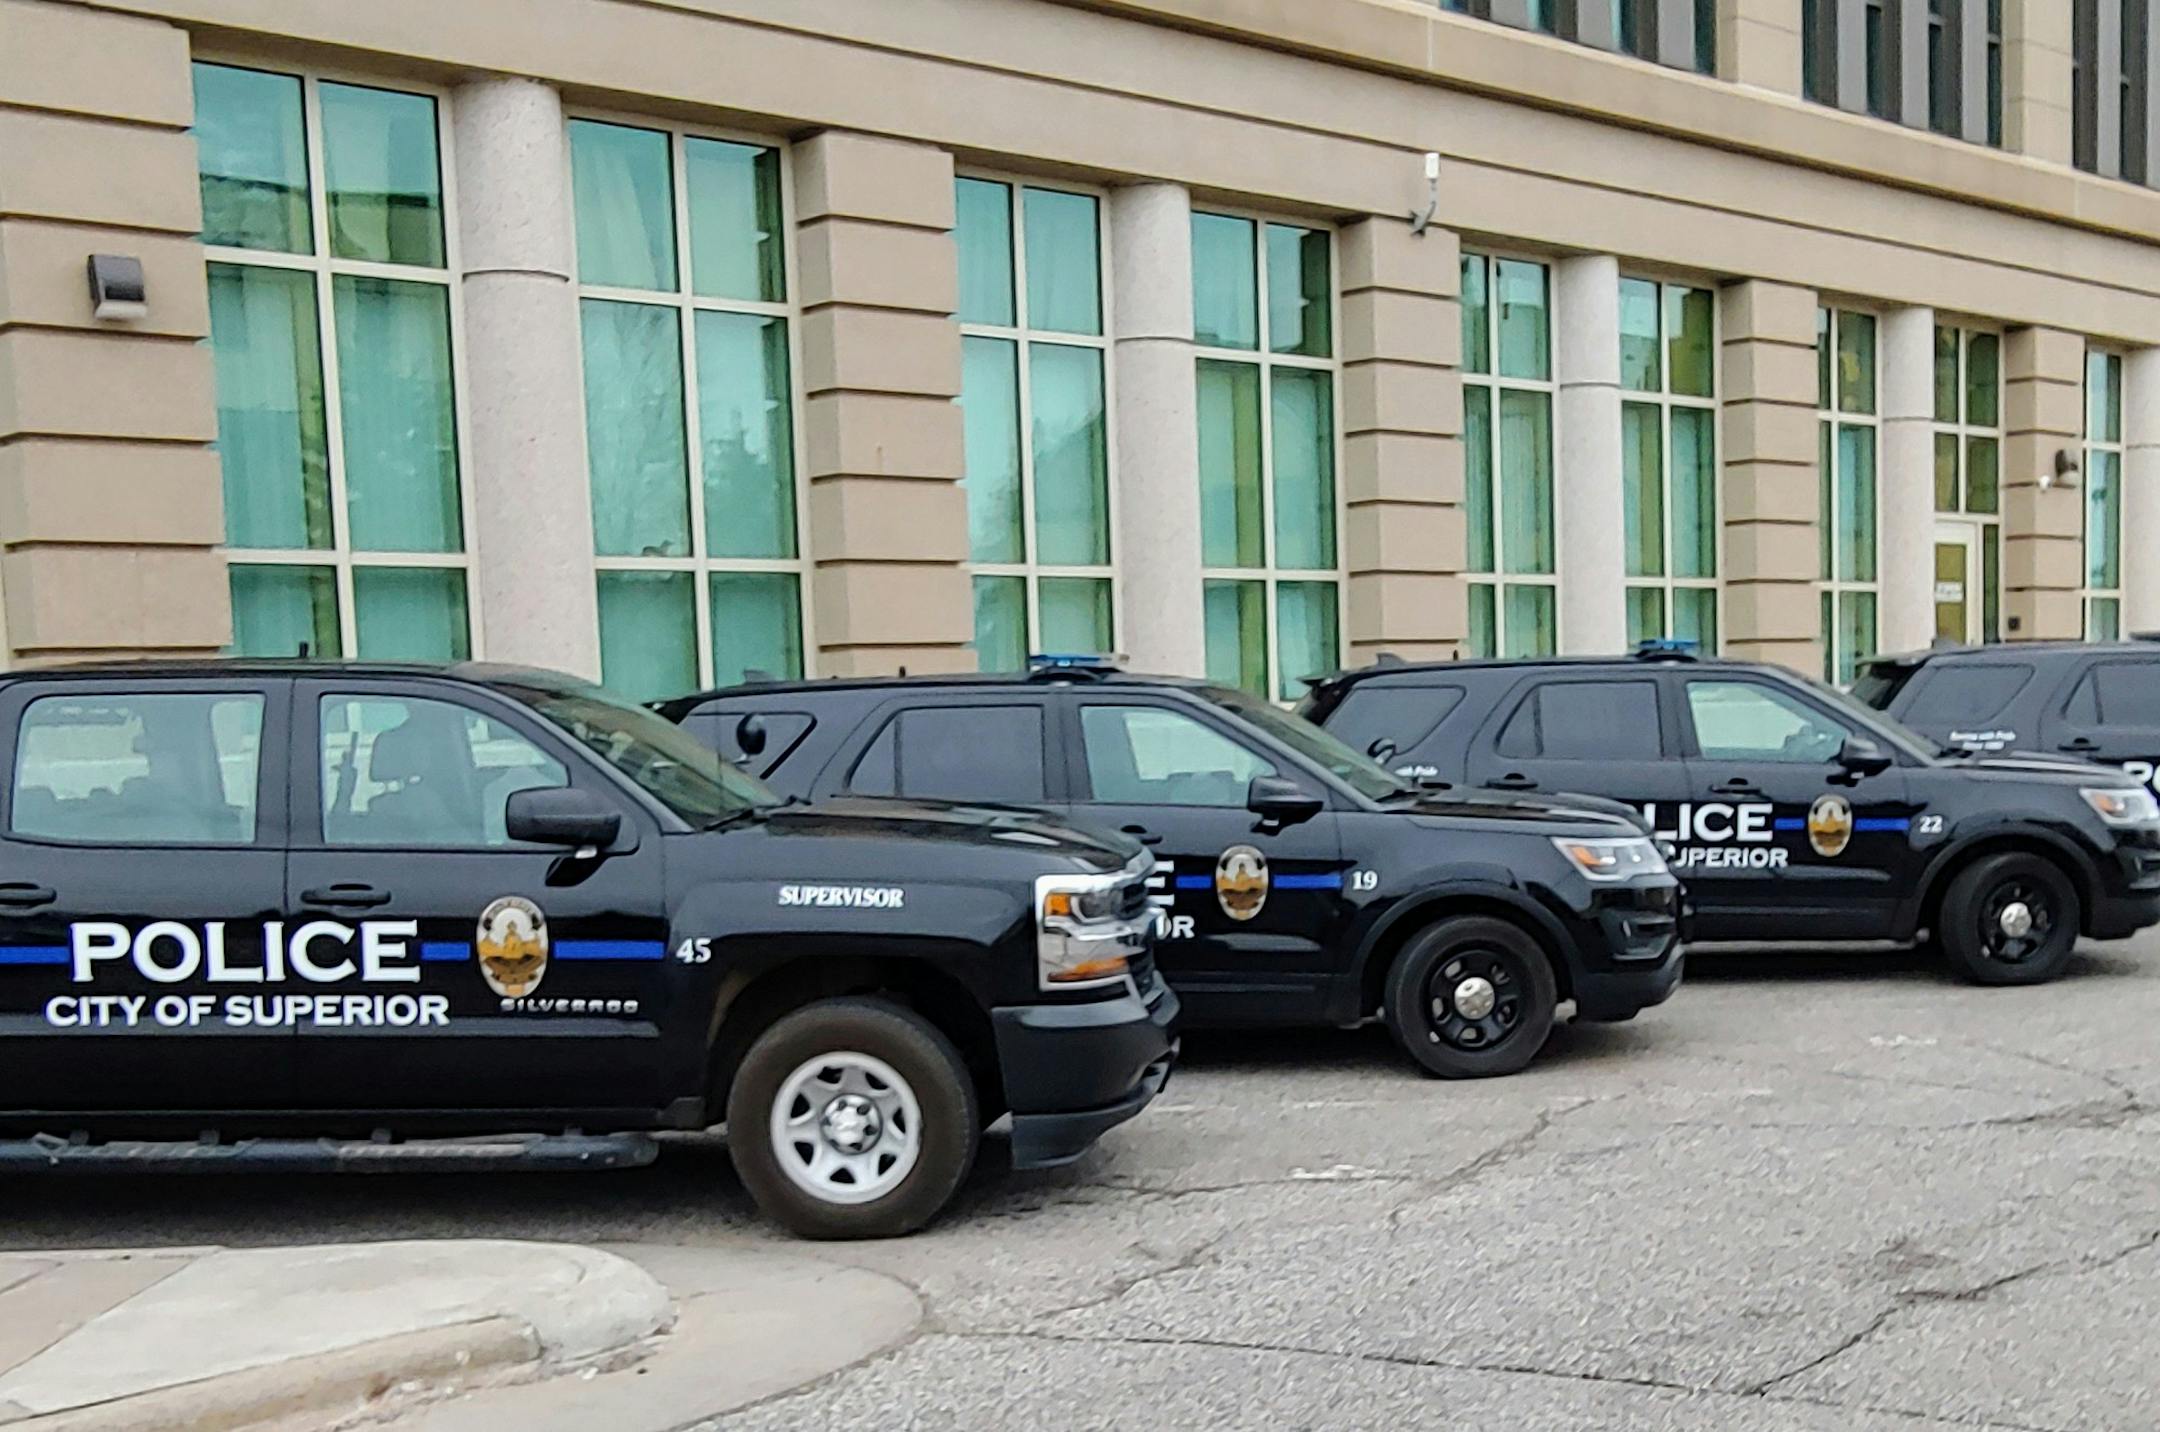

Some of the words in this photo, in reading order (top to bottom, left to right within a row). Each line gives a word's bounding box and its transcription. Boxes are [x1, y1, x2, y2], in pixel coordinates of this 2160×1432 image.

[1643, 803, 1773, 842] LICE
[1919, 815, 1943, 834] 22
[1675, 847, 1788, 869] UPERIOR
[1352, 870, 1379, 891] 19
[778, 885, 905, 909] SUPERVISOR
[70, 919, 421, 982] POLICE
[675, 937, 712, 964] 45
[45, 995, 147, 1027] CITY
[154, 995, 216, 1027] OF
[224, 995, 450, 1027] SUPERIOR
[500, 998, 639, 1014] SILVERADO
